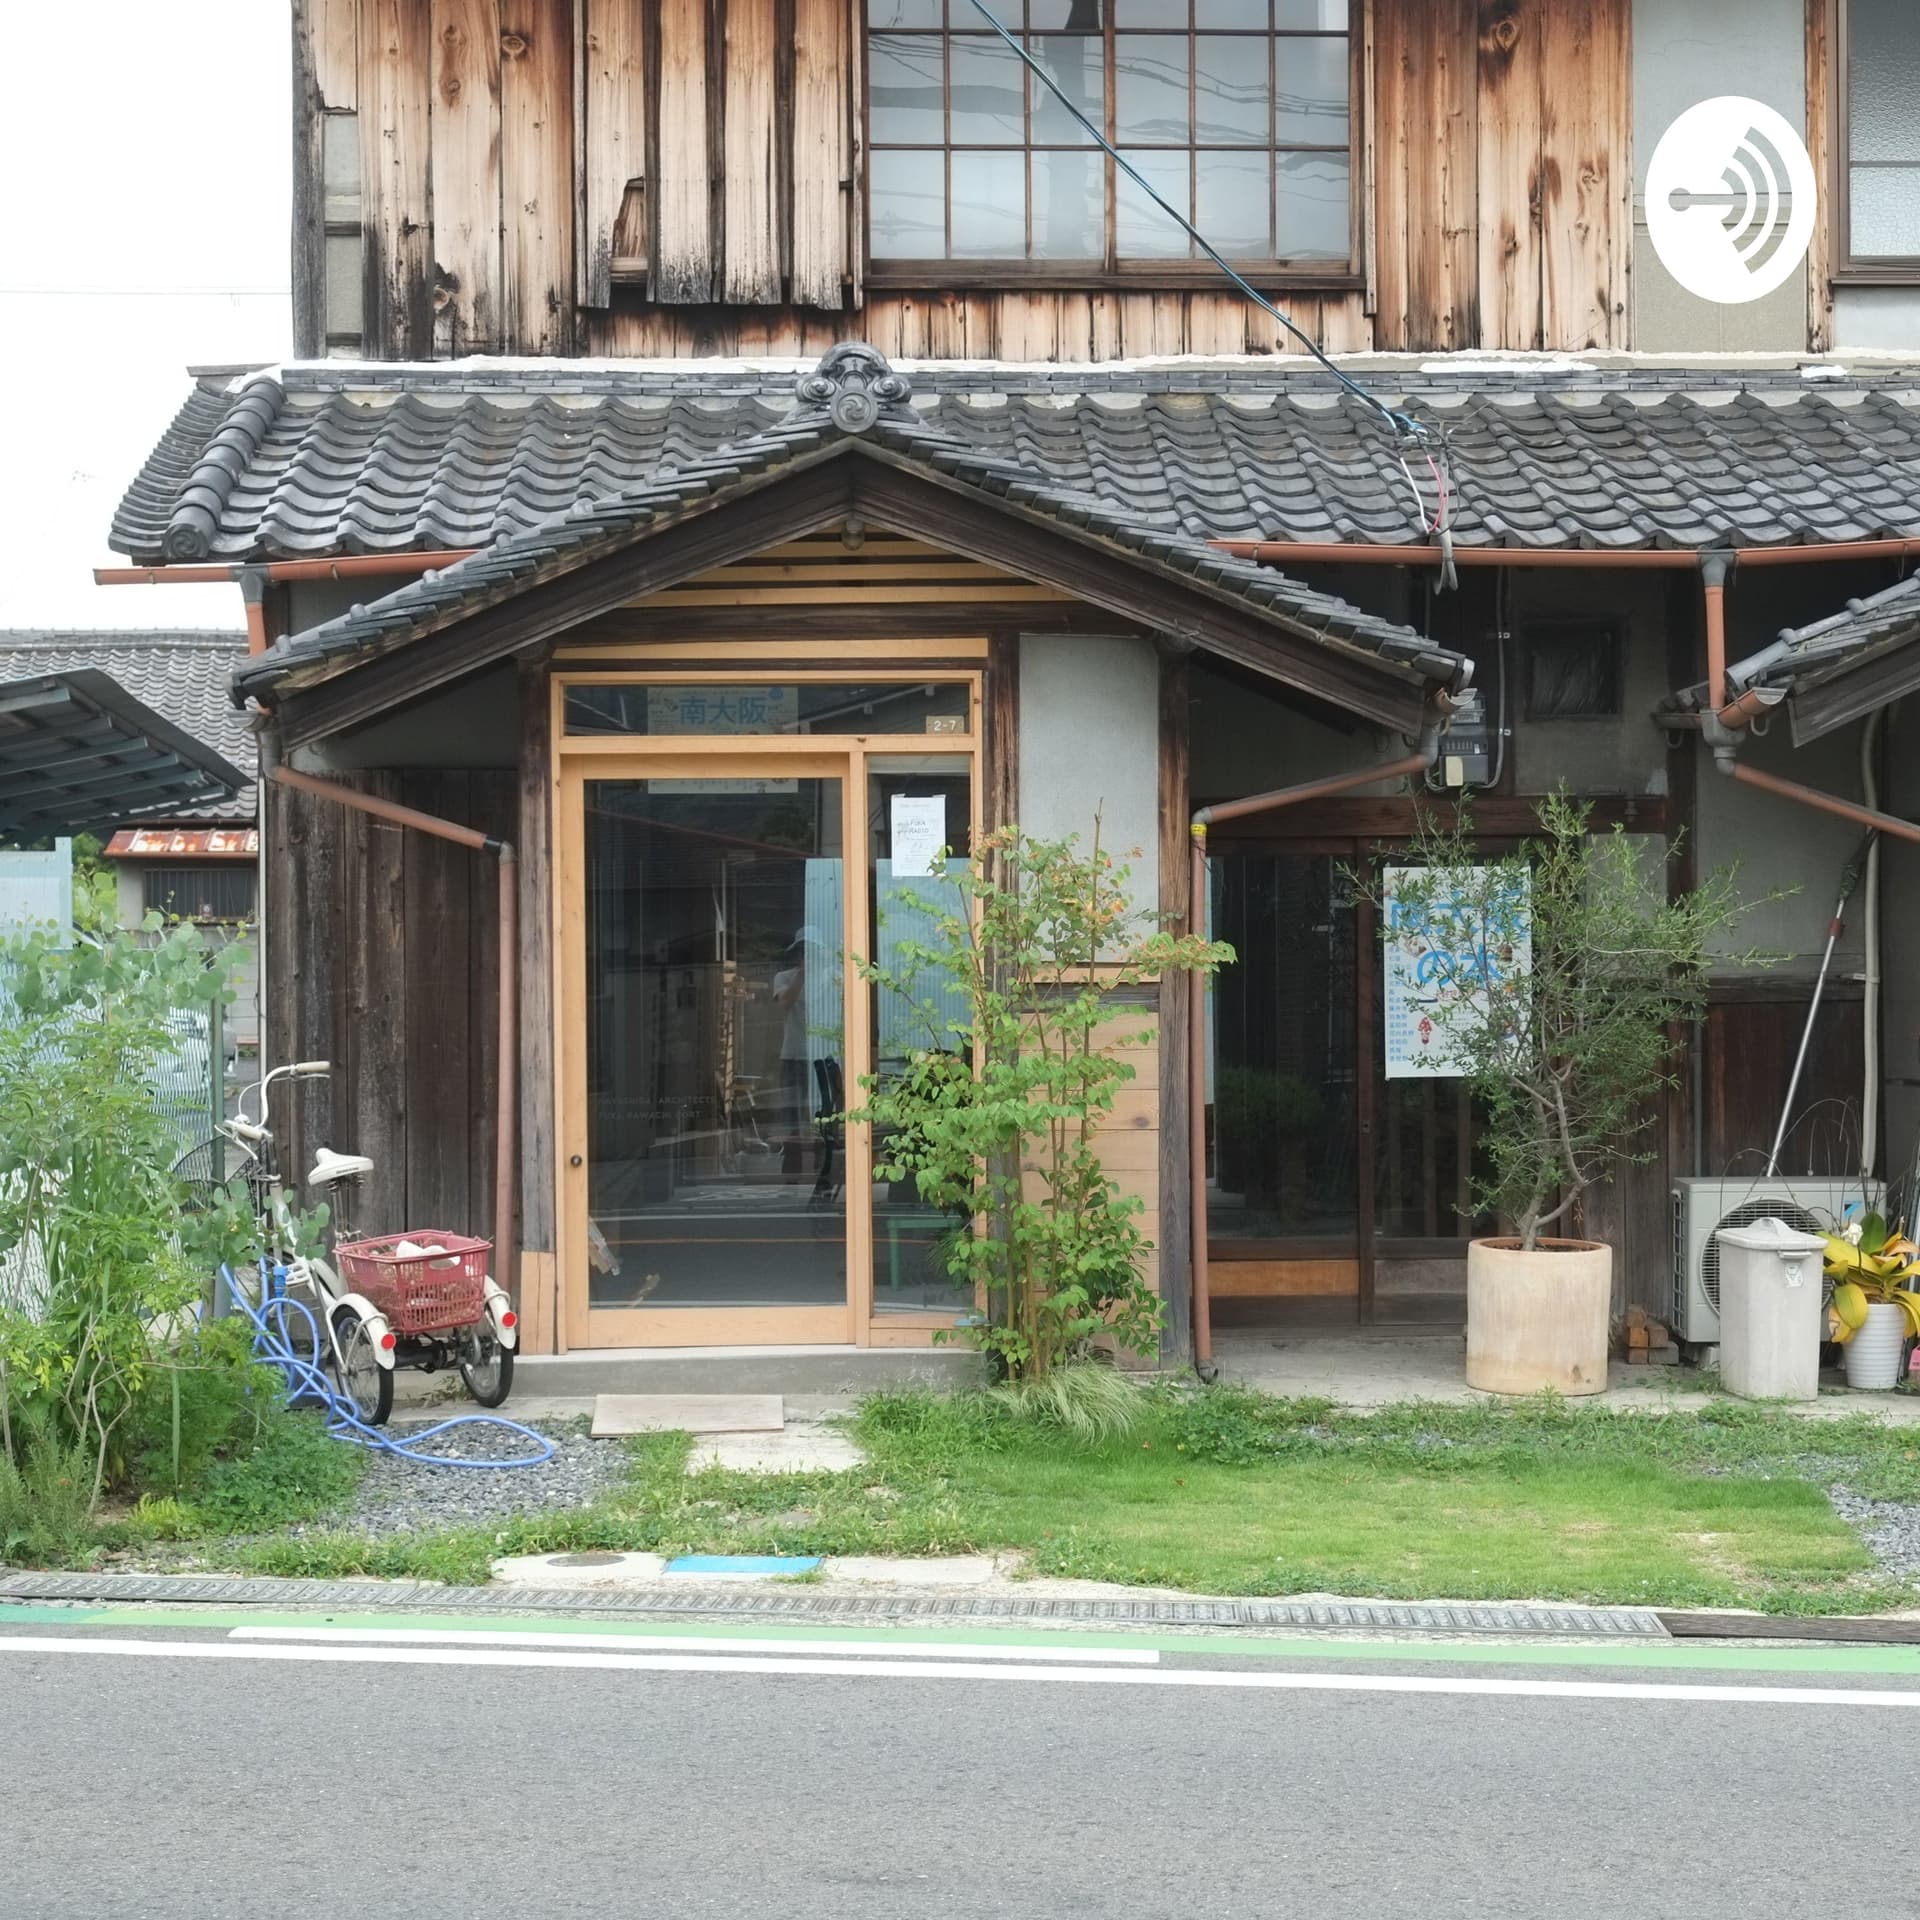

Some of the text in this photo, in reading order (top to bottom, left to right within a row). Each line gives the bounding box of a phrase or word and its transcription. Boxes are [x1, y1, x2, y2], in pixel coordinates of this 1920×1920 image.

[680, 696, 768, 724] 南大阪
[934, 720, 956, 731] 2-7
